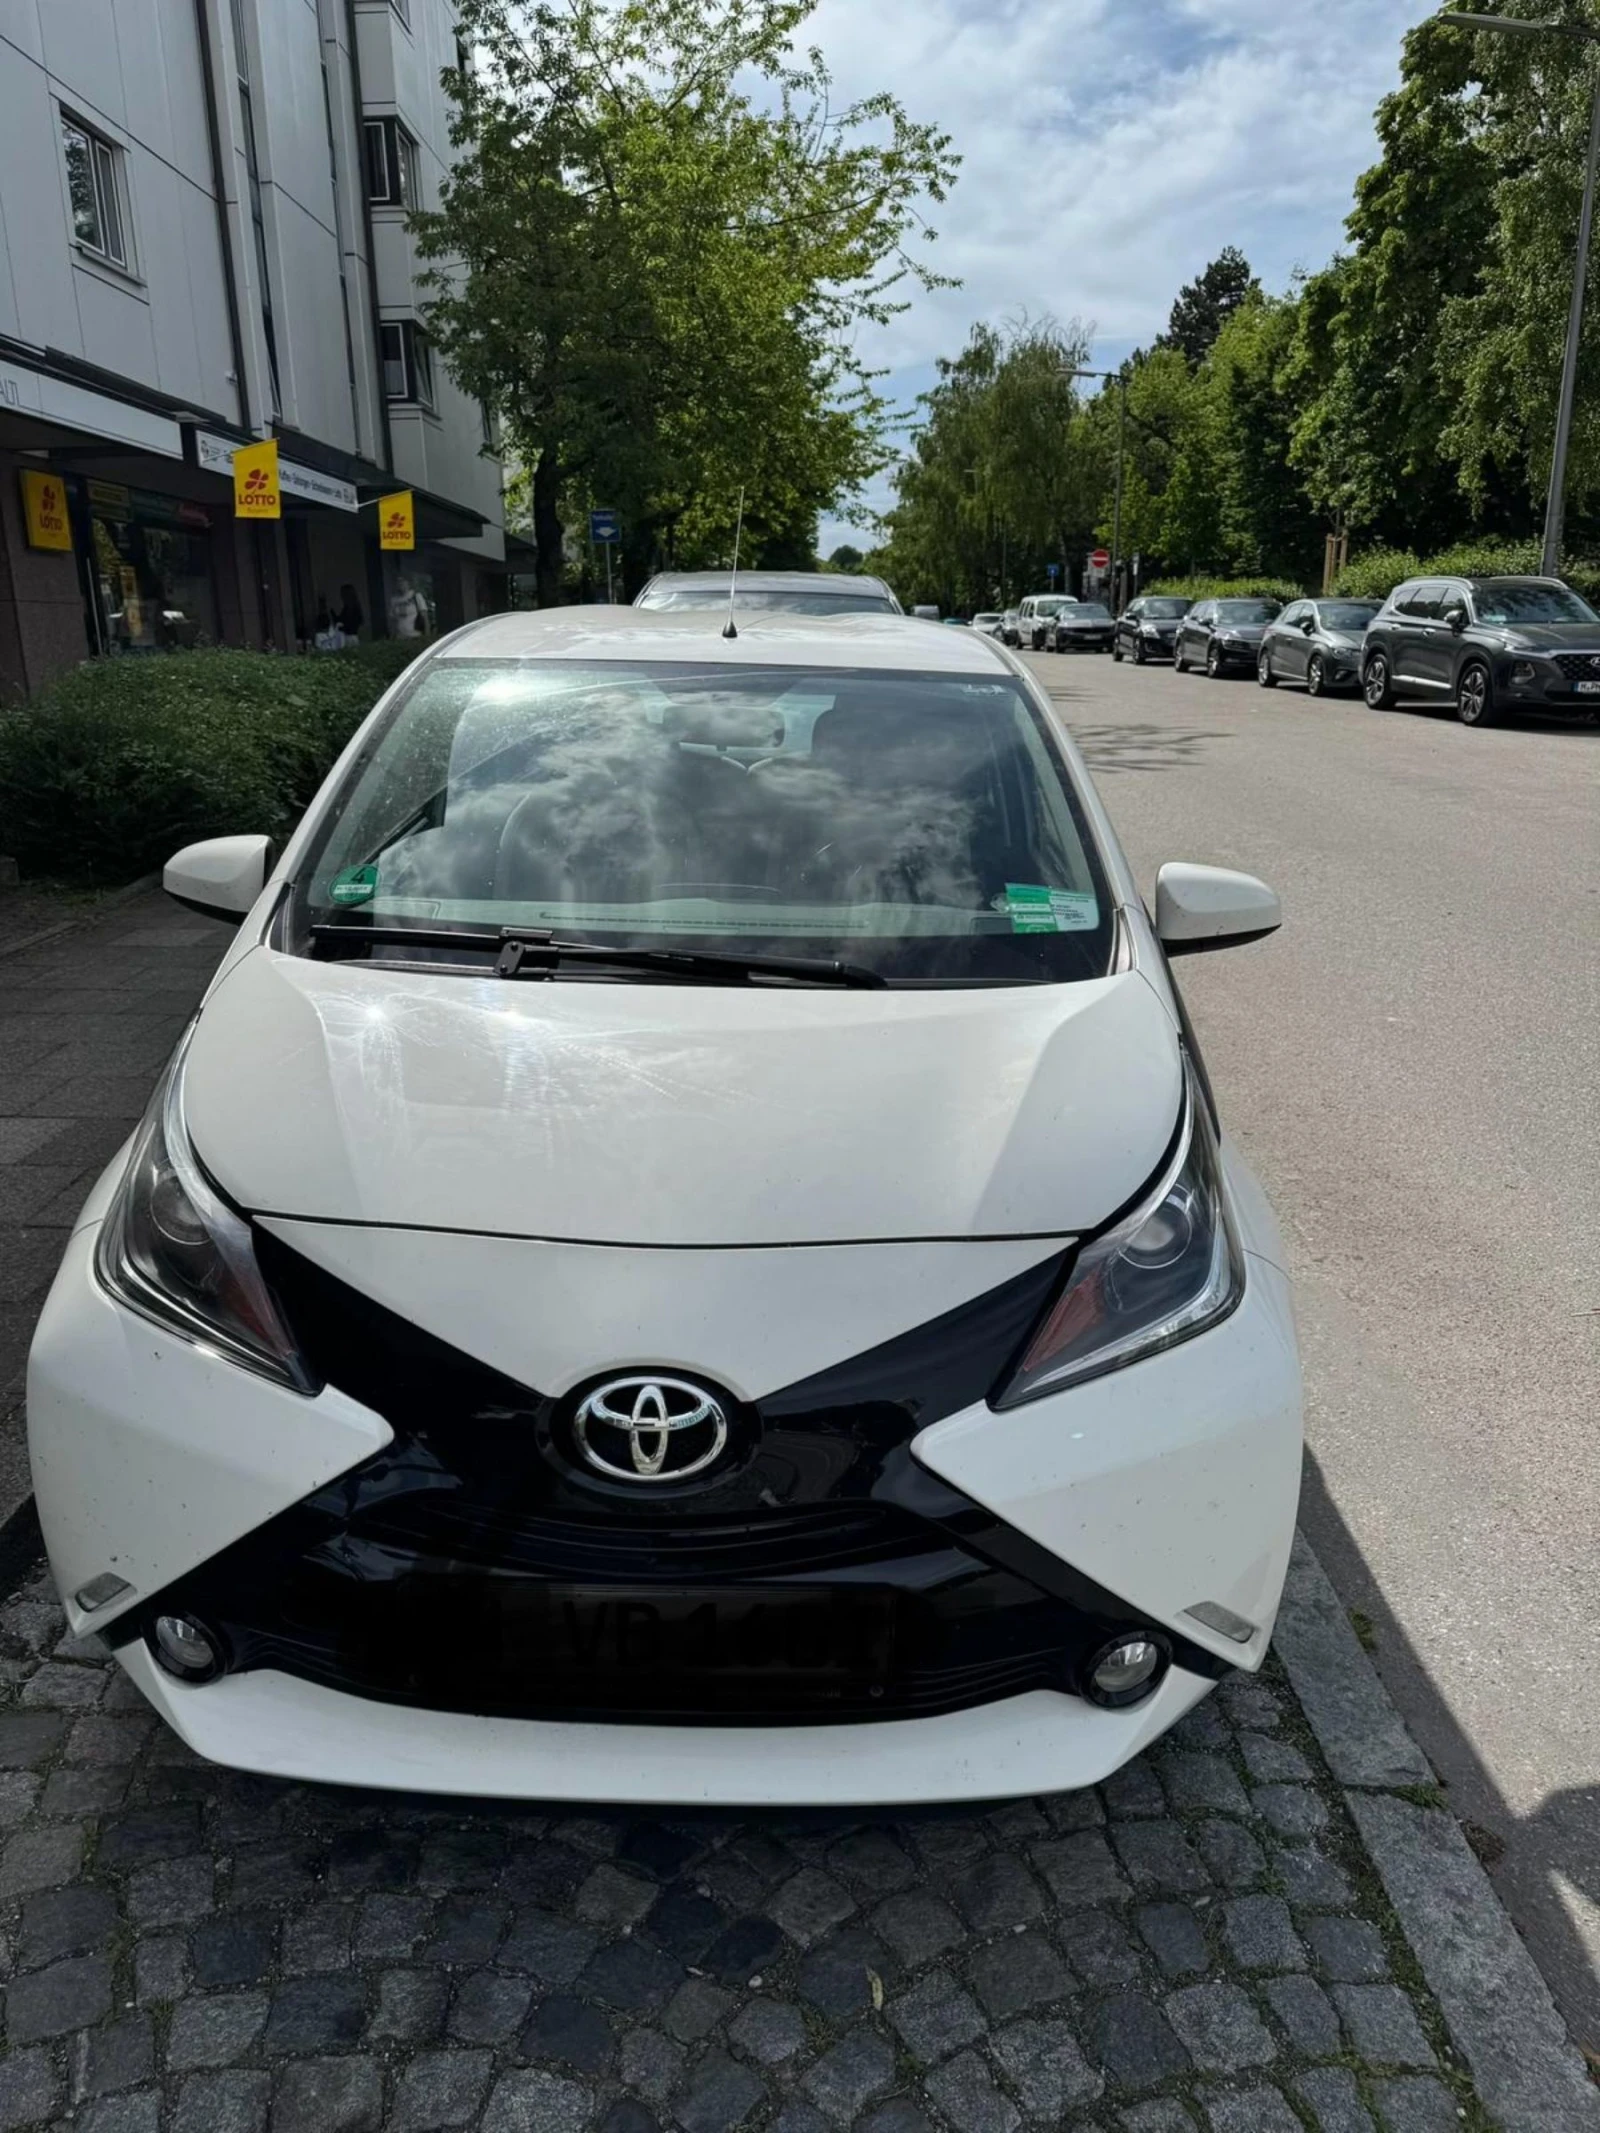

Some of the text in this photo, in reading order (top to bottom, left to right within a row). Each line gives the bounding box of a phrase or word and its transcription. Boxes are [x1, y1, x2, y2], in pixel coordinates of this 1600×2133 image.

[238, 494, 276, 505] LOTTO
[39, 512, 63, 530] LOTTO
[383, 531, 411, 540] LOTTO
[350, 867, 366, 884] 4
